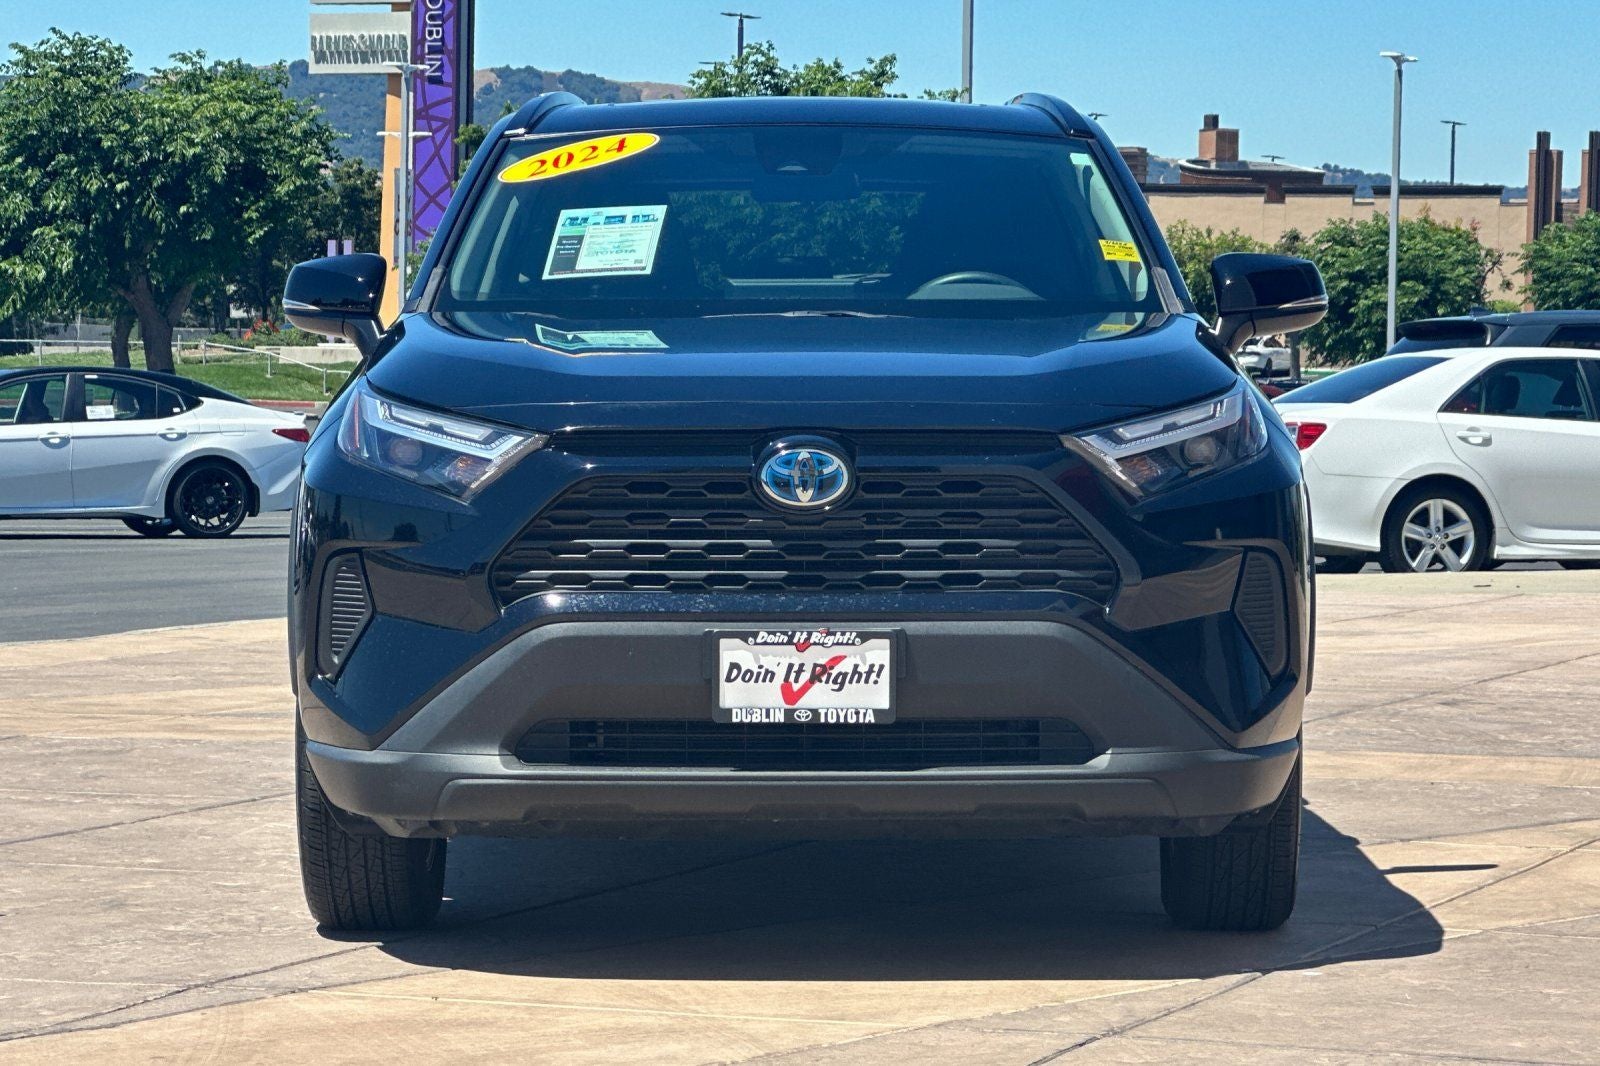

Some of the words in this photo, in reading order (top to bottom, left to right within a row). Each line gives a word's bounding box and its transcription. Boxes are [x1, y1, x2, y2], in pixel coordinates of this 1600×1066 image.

[424, 0, 443, 76] DUBLIN
[527, 137, 628, 179] 2024
[755, 630, 791, 644] Doin'
[793, 631, 808, 644] It
[809, 630, 856, 648] Right!
[724, 661, 781, 684] Doin'
[784, 662, 805, 684] It
[808, 662, 886, 692] Right!
[731, 708, 785, 723] DUBLIN
[818, 708, 875, 723] TOYOTA
